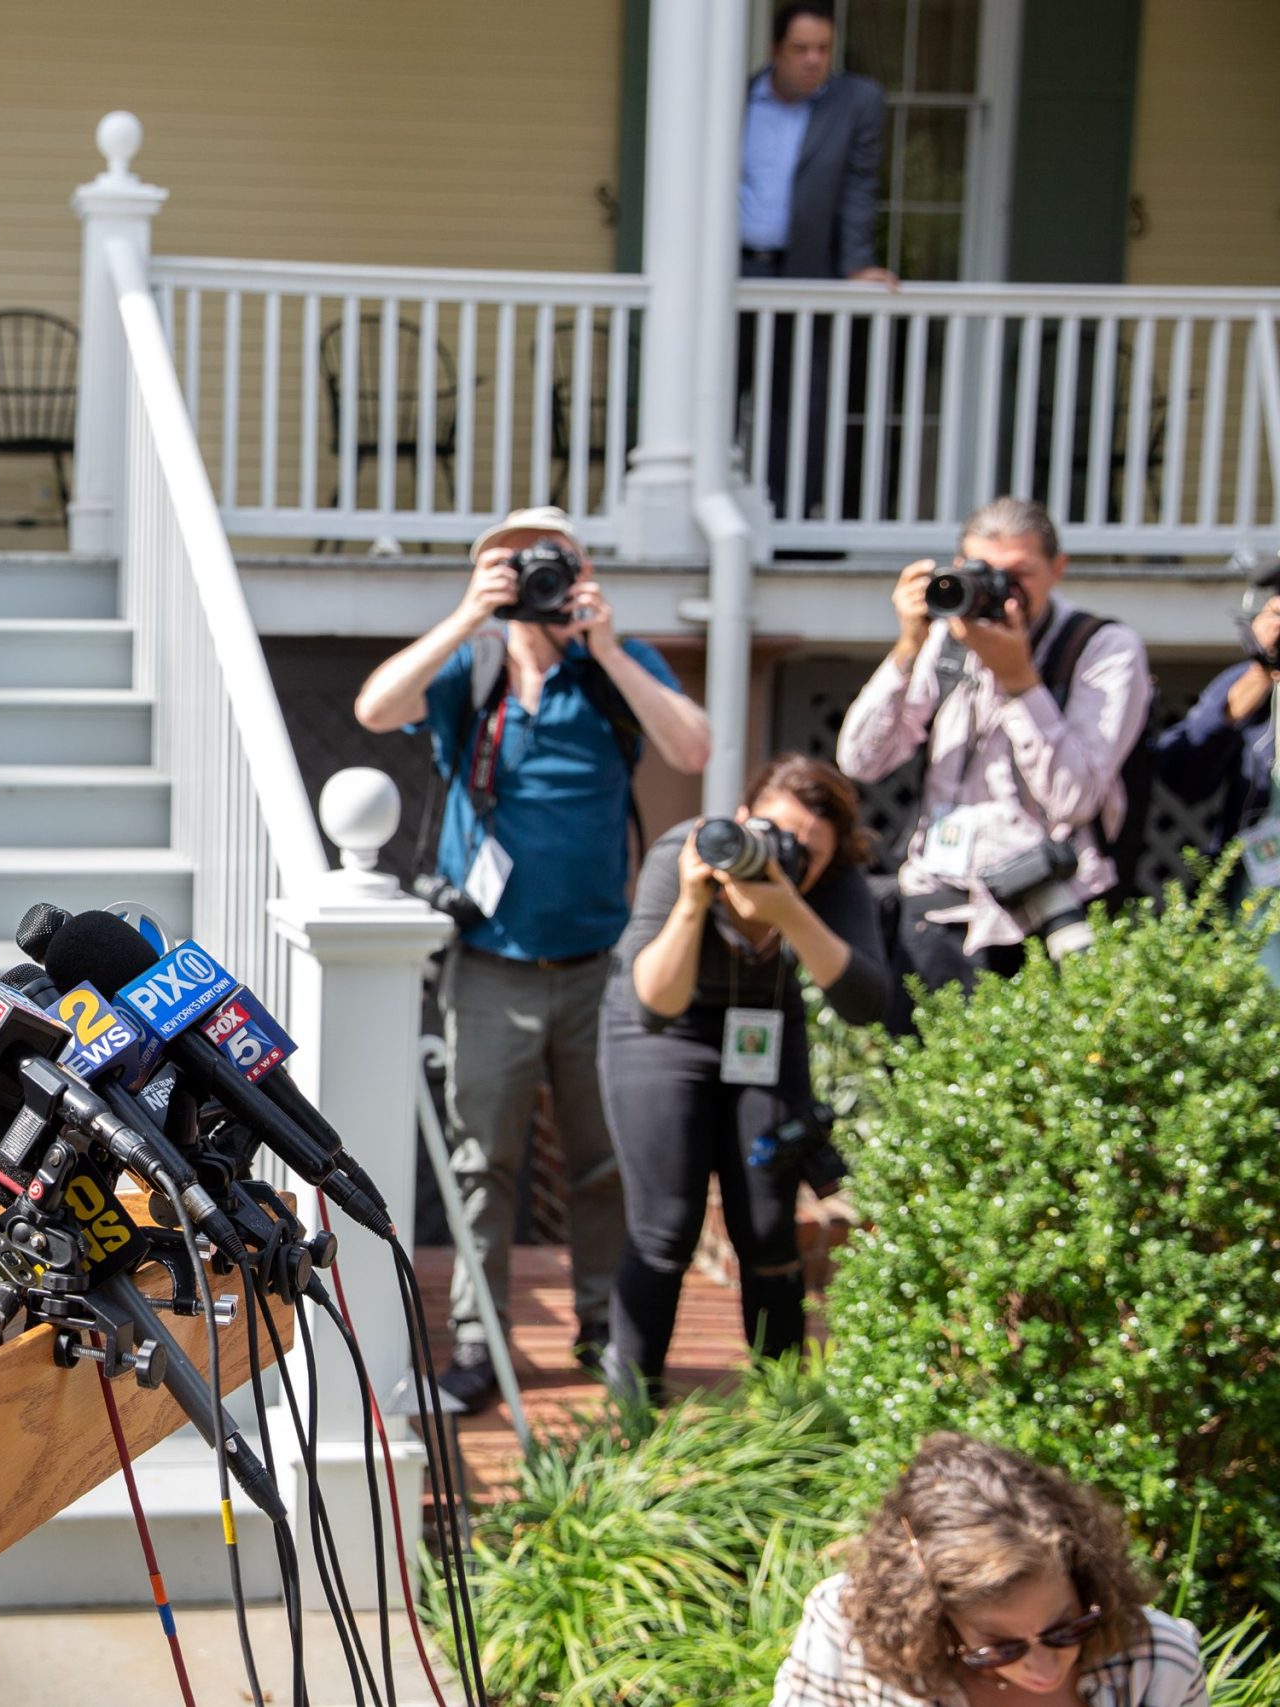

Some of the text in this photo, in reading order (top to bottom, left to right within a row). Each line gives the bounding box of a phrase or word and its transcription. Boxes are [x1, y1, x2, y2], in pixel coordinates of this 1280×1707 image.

[127, 963, 198, 1020] PIX
[160, 1018, 179, 1034] NEW
[176, 1001, 201, 1021] YORK'S
[196, 989, 216, 1006] VERY
[213, 978, 231, 993] OWN
[59, 989, 118, 1046] 2
[205, 1006, 244, 1044] FOX
[66, 1026, 131, 1077] EWS
[227, 1026, 262, 1065] 5
[141, 1077, 175, 1096] SPECTRUM
[144, 1085, 174, 1111] NE
